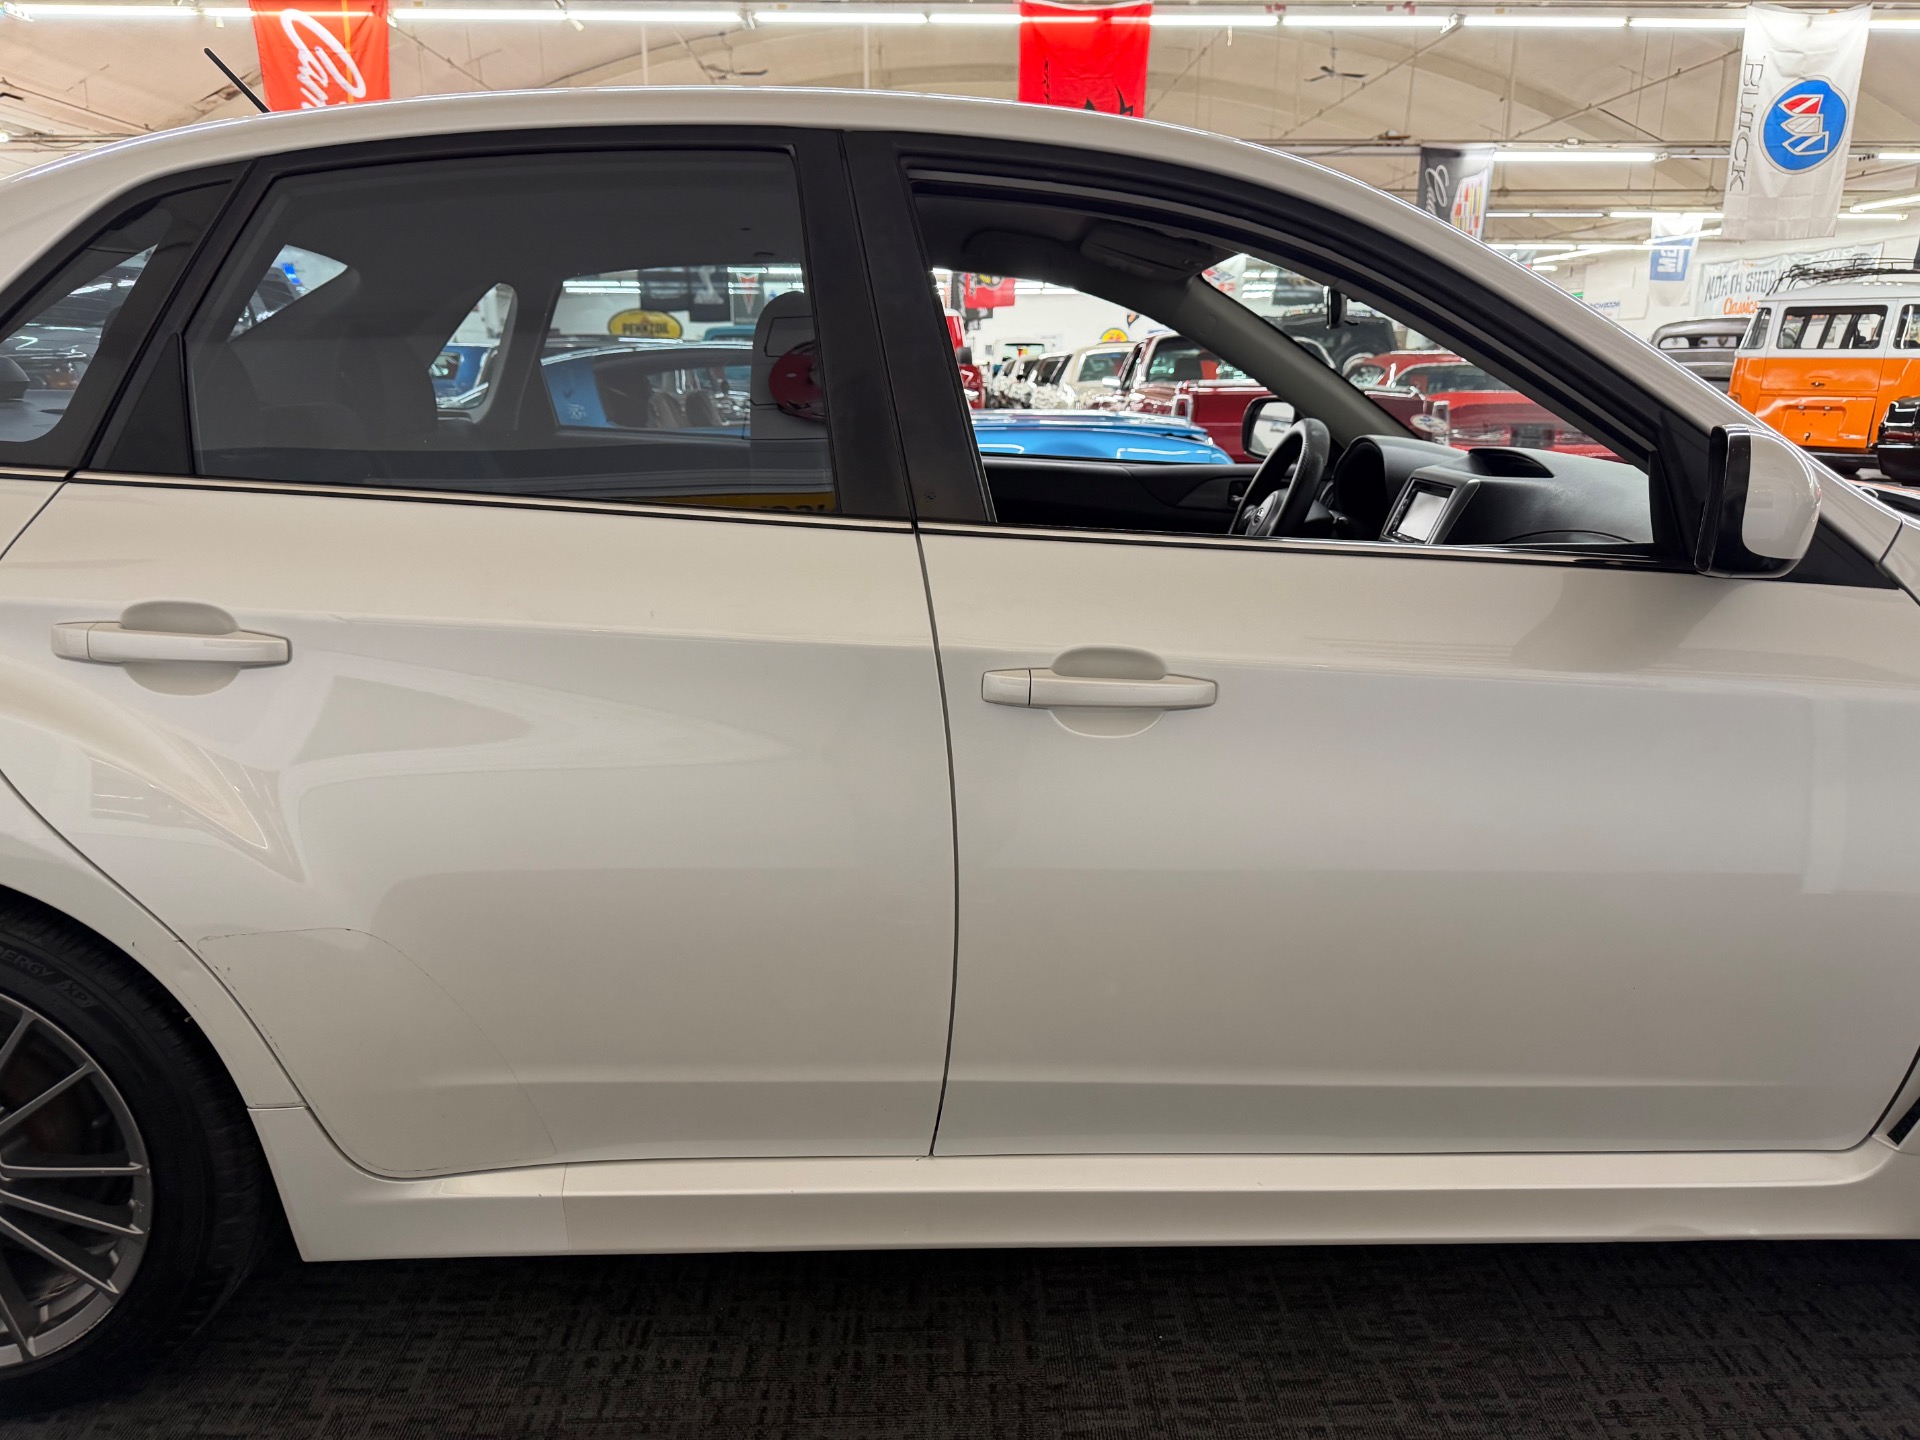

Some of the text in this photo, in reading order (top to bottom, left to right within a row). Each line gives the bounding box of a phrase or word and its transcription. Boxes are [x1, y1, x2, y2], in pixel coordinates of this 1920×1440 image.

[1729, 54, 1766, 192] BUICK
[1745, 269, 1782, 293] SHOR
[0, 945, 54, 977] ERGY
